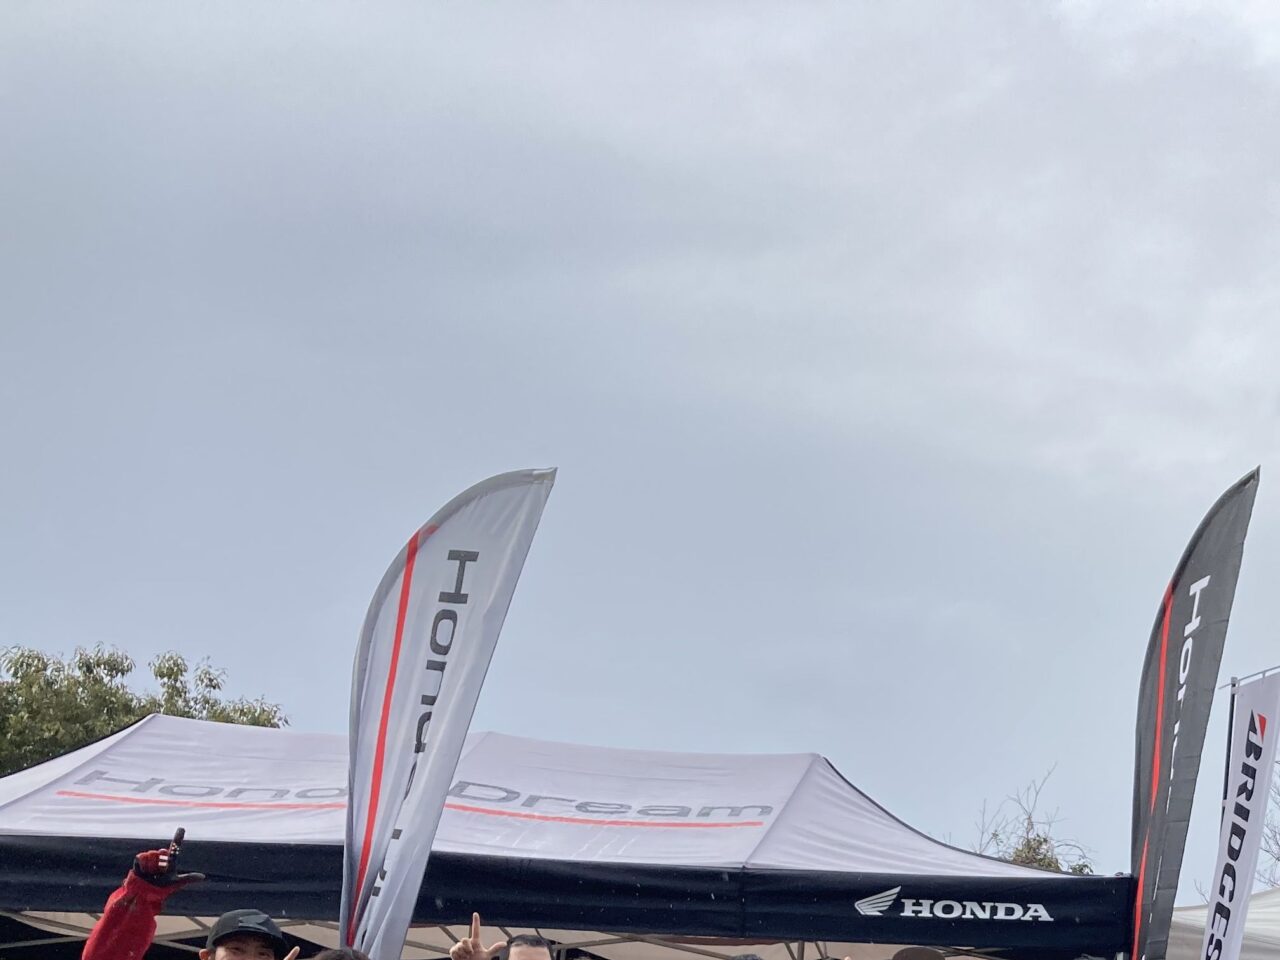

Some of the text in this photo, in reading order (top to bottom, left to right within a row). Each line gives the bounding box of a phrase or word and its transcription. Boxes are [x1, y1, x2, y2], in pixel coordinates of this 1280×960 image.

[74, 770, 774, 818] Hond Dream
[900, 898, 1054, 922] HONDA
